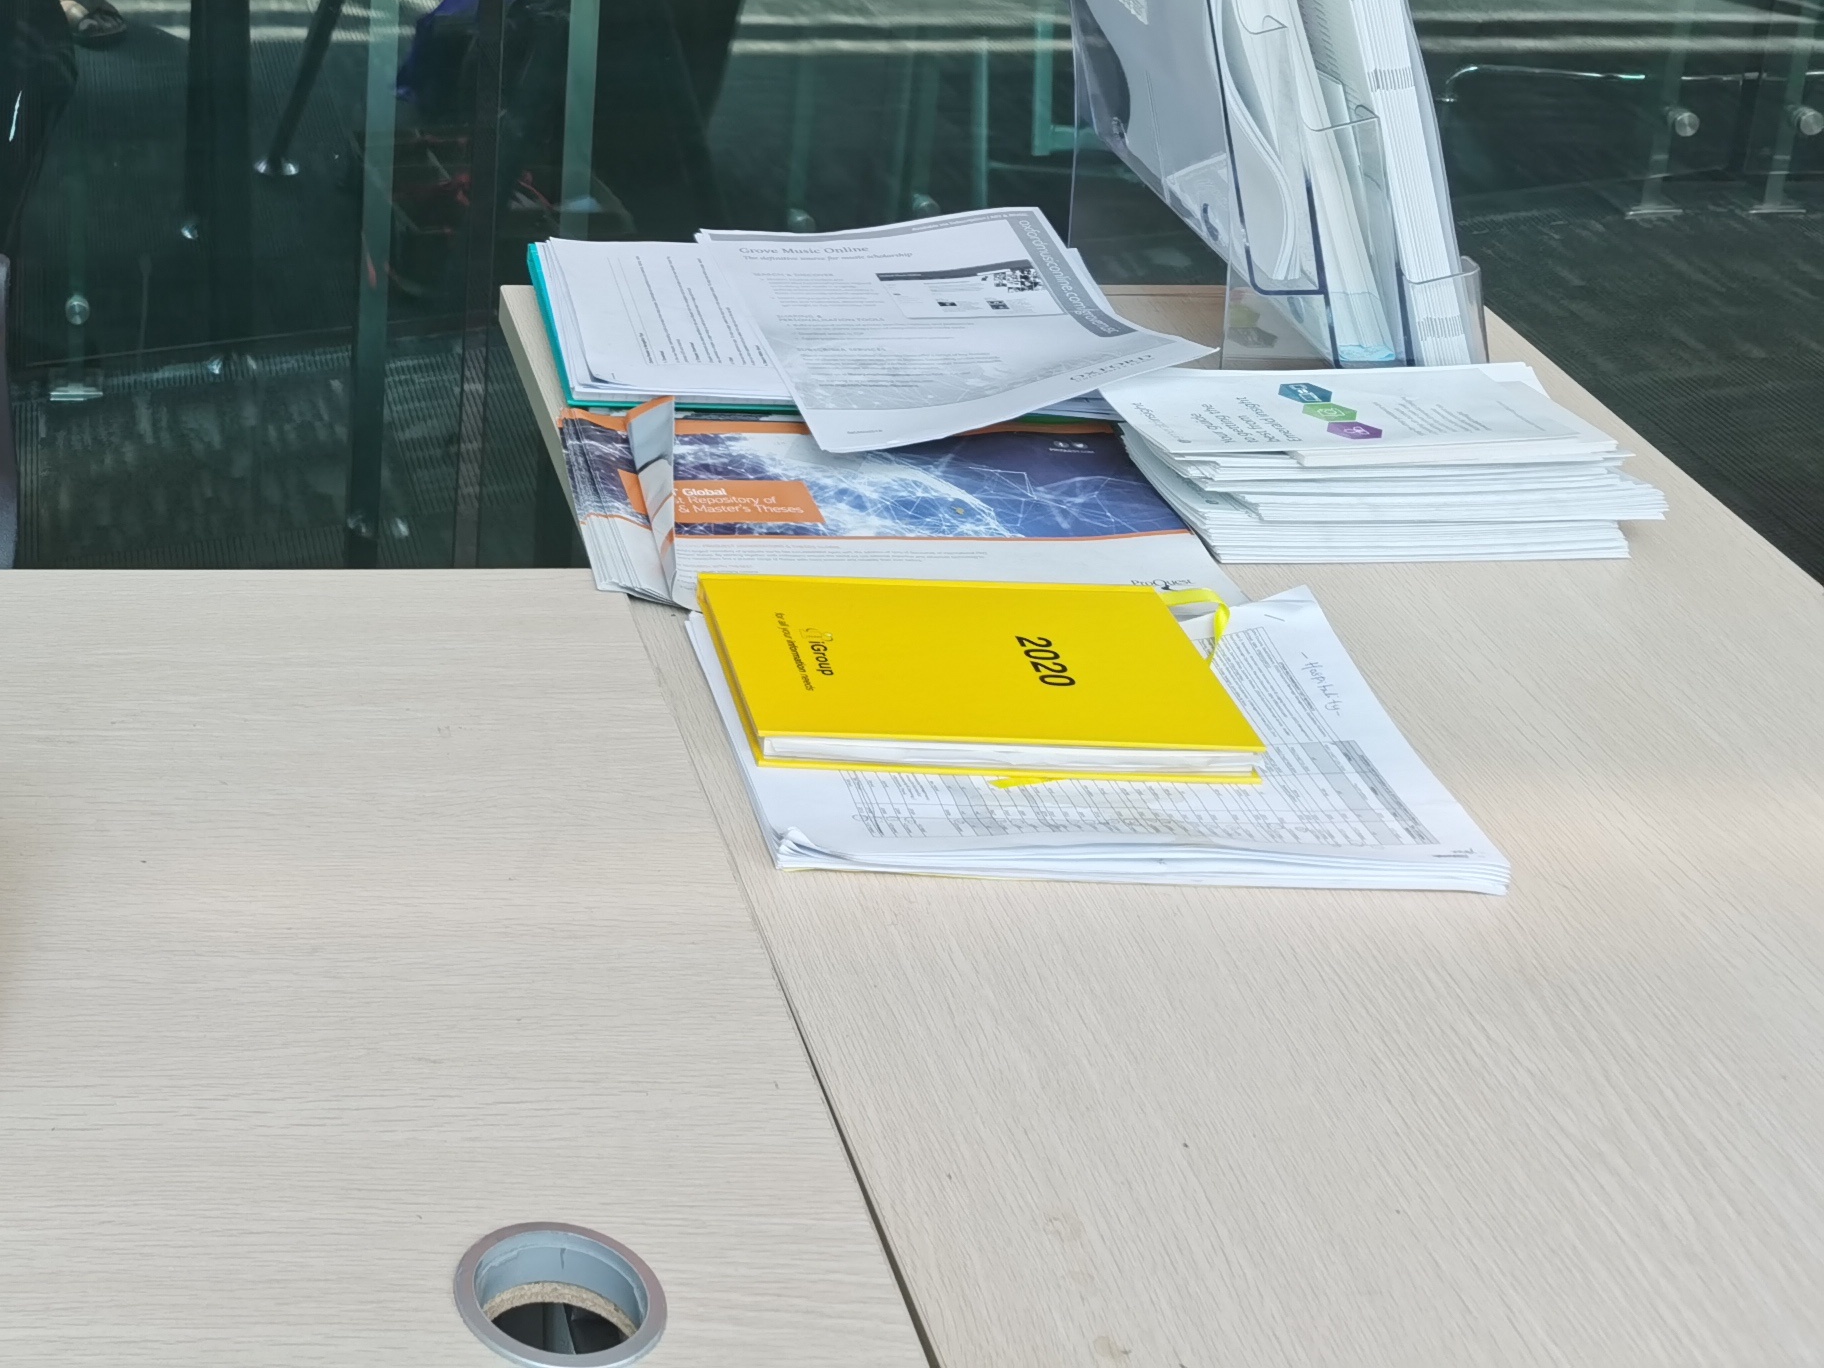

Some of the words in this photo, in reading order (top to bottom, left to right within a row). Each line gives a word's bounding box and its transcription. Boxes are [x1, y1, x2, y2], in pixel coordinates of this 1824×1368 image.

[738, 246, 779, 255] Grove
[782, 247, 821, 255] Music
[823, 245, 870, 254] Online
[866, 250, 914, 260] scholarship
[682, 487, 727, 497] Global
[687, 495, 760, 507] Repository
[762, 495, 777, 504] of
[678, 504, 690, 514] &
[692, 504, 753, 514] Master's
[754, 505, 805, 514] Theses
[1130, 577, 1195, 592] ProQuest
[808, 640, 835, 676] iGroup
[1015, 634, 1077, 688] 2020
